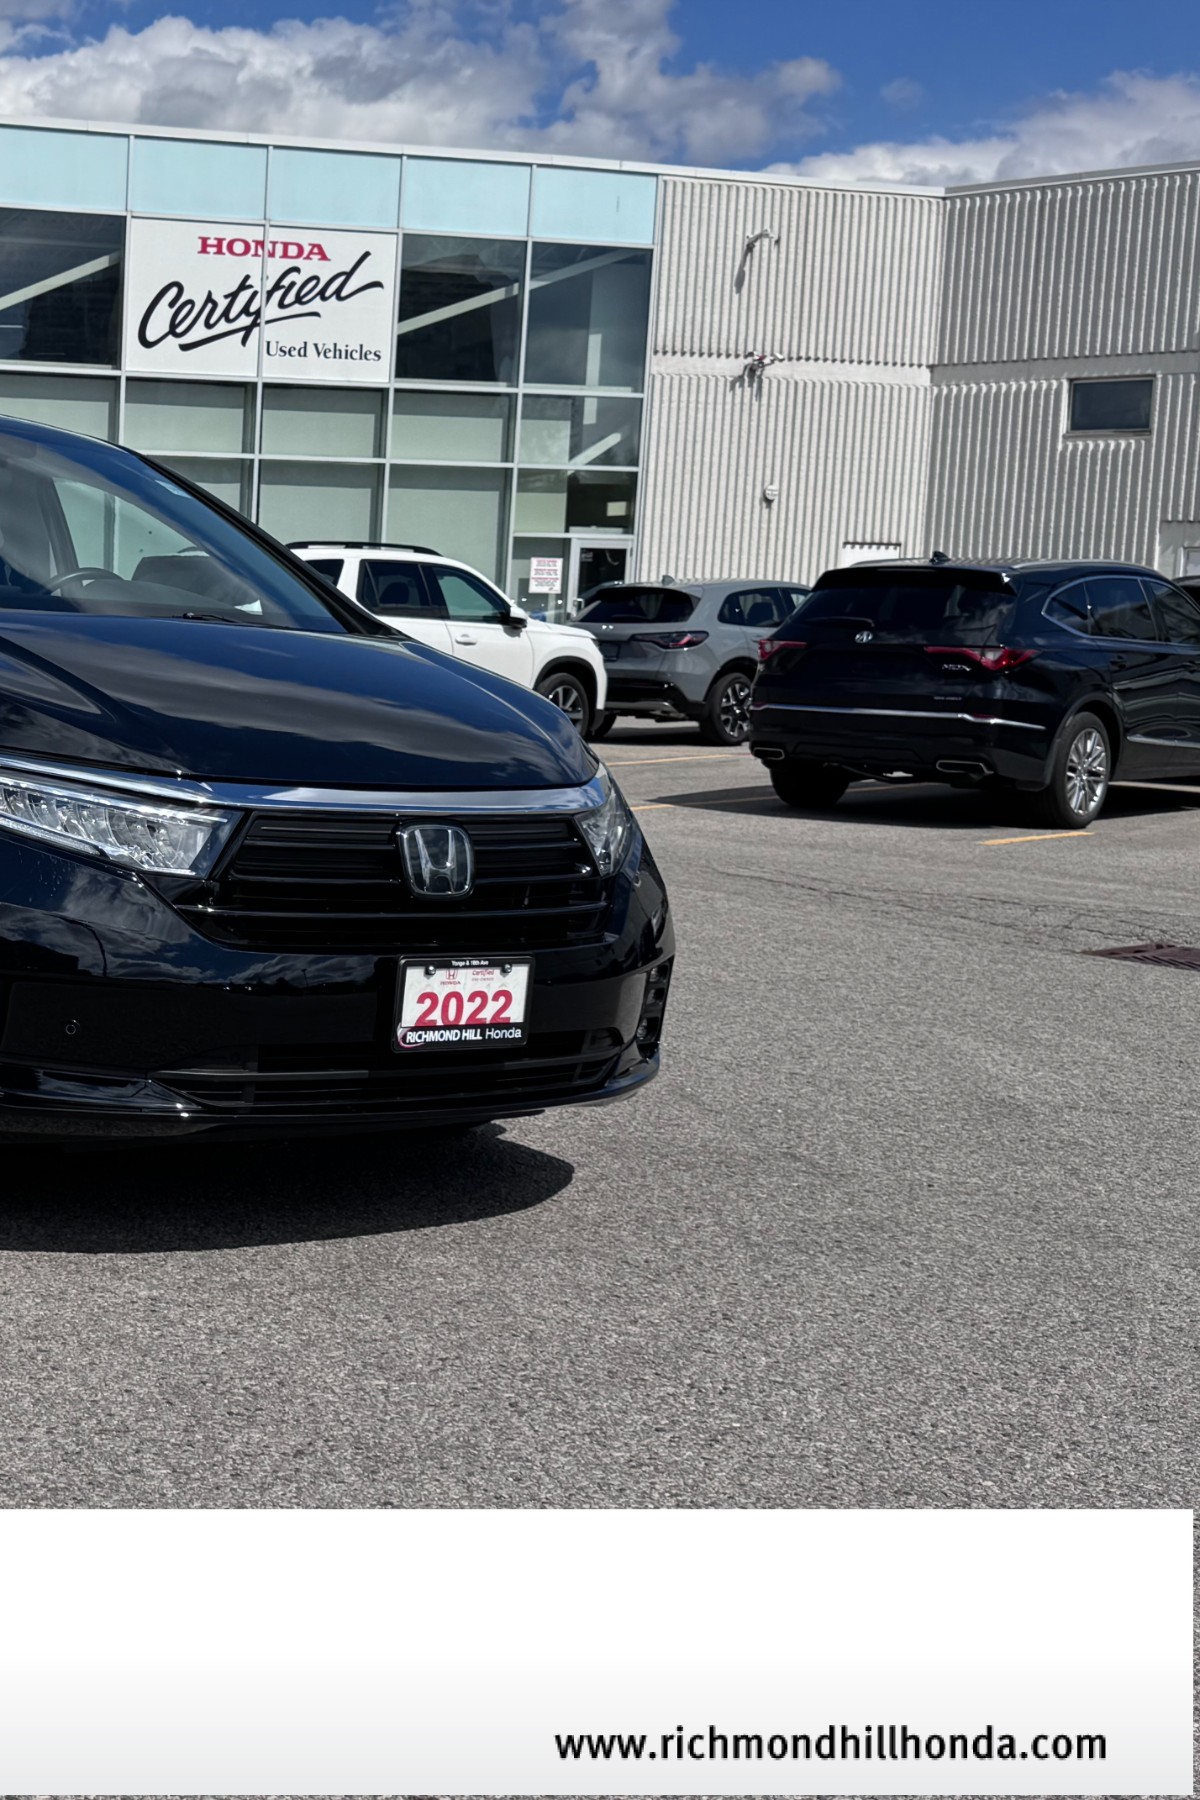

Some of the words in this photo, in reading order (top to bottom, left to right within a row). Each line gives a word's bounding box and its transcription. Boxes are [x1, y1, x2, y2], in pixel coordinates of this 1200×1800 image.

[197, 236, 331, 261] HONDA
[137, 250, 385, 350] Certified
[266, 340, 308, 358] Used
[313, 343, 382, 362] Vehicles
[414, 989, 513, 1027] 2022
[406, 1029, 461, 1043] RICHMOND
[462, 1028, 483, 1040] HILL
[485, 1027, 522, 1039] Honda
